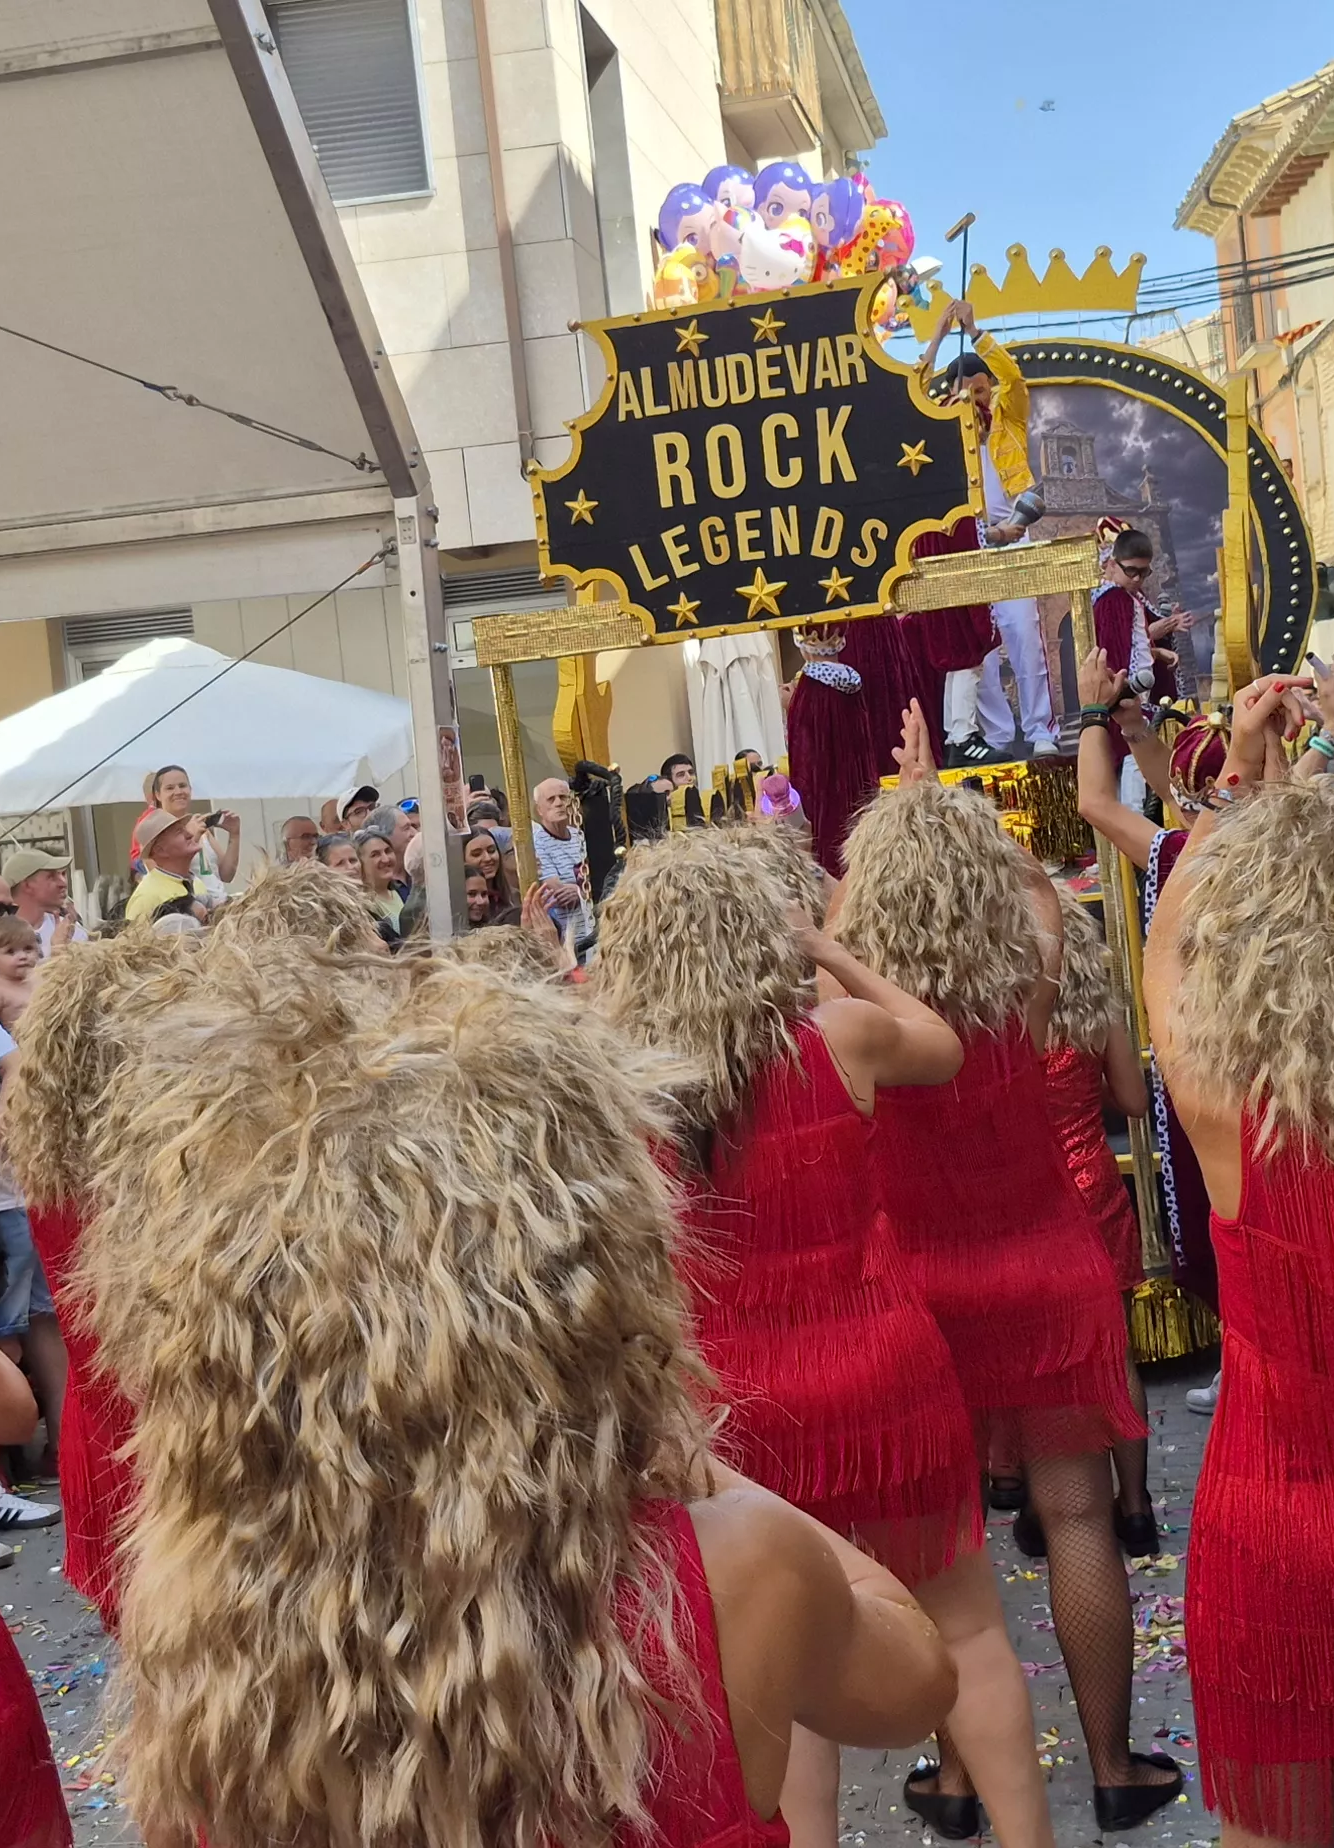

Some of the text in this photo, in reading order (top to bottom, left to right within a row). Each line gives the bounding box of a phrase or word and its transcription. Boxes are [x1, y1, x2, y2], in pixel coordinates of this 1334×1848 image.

[617, 333, 868, 422] ALMUDEVAR
[652, 405, 858, 509] ROCK
[628, 505, 888, 592] LEGENDS
